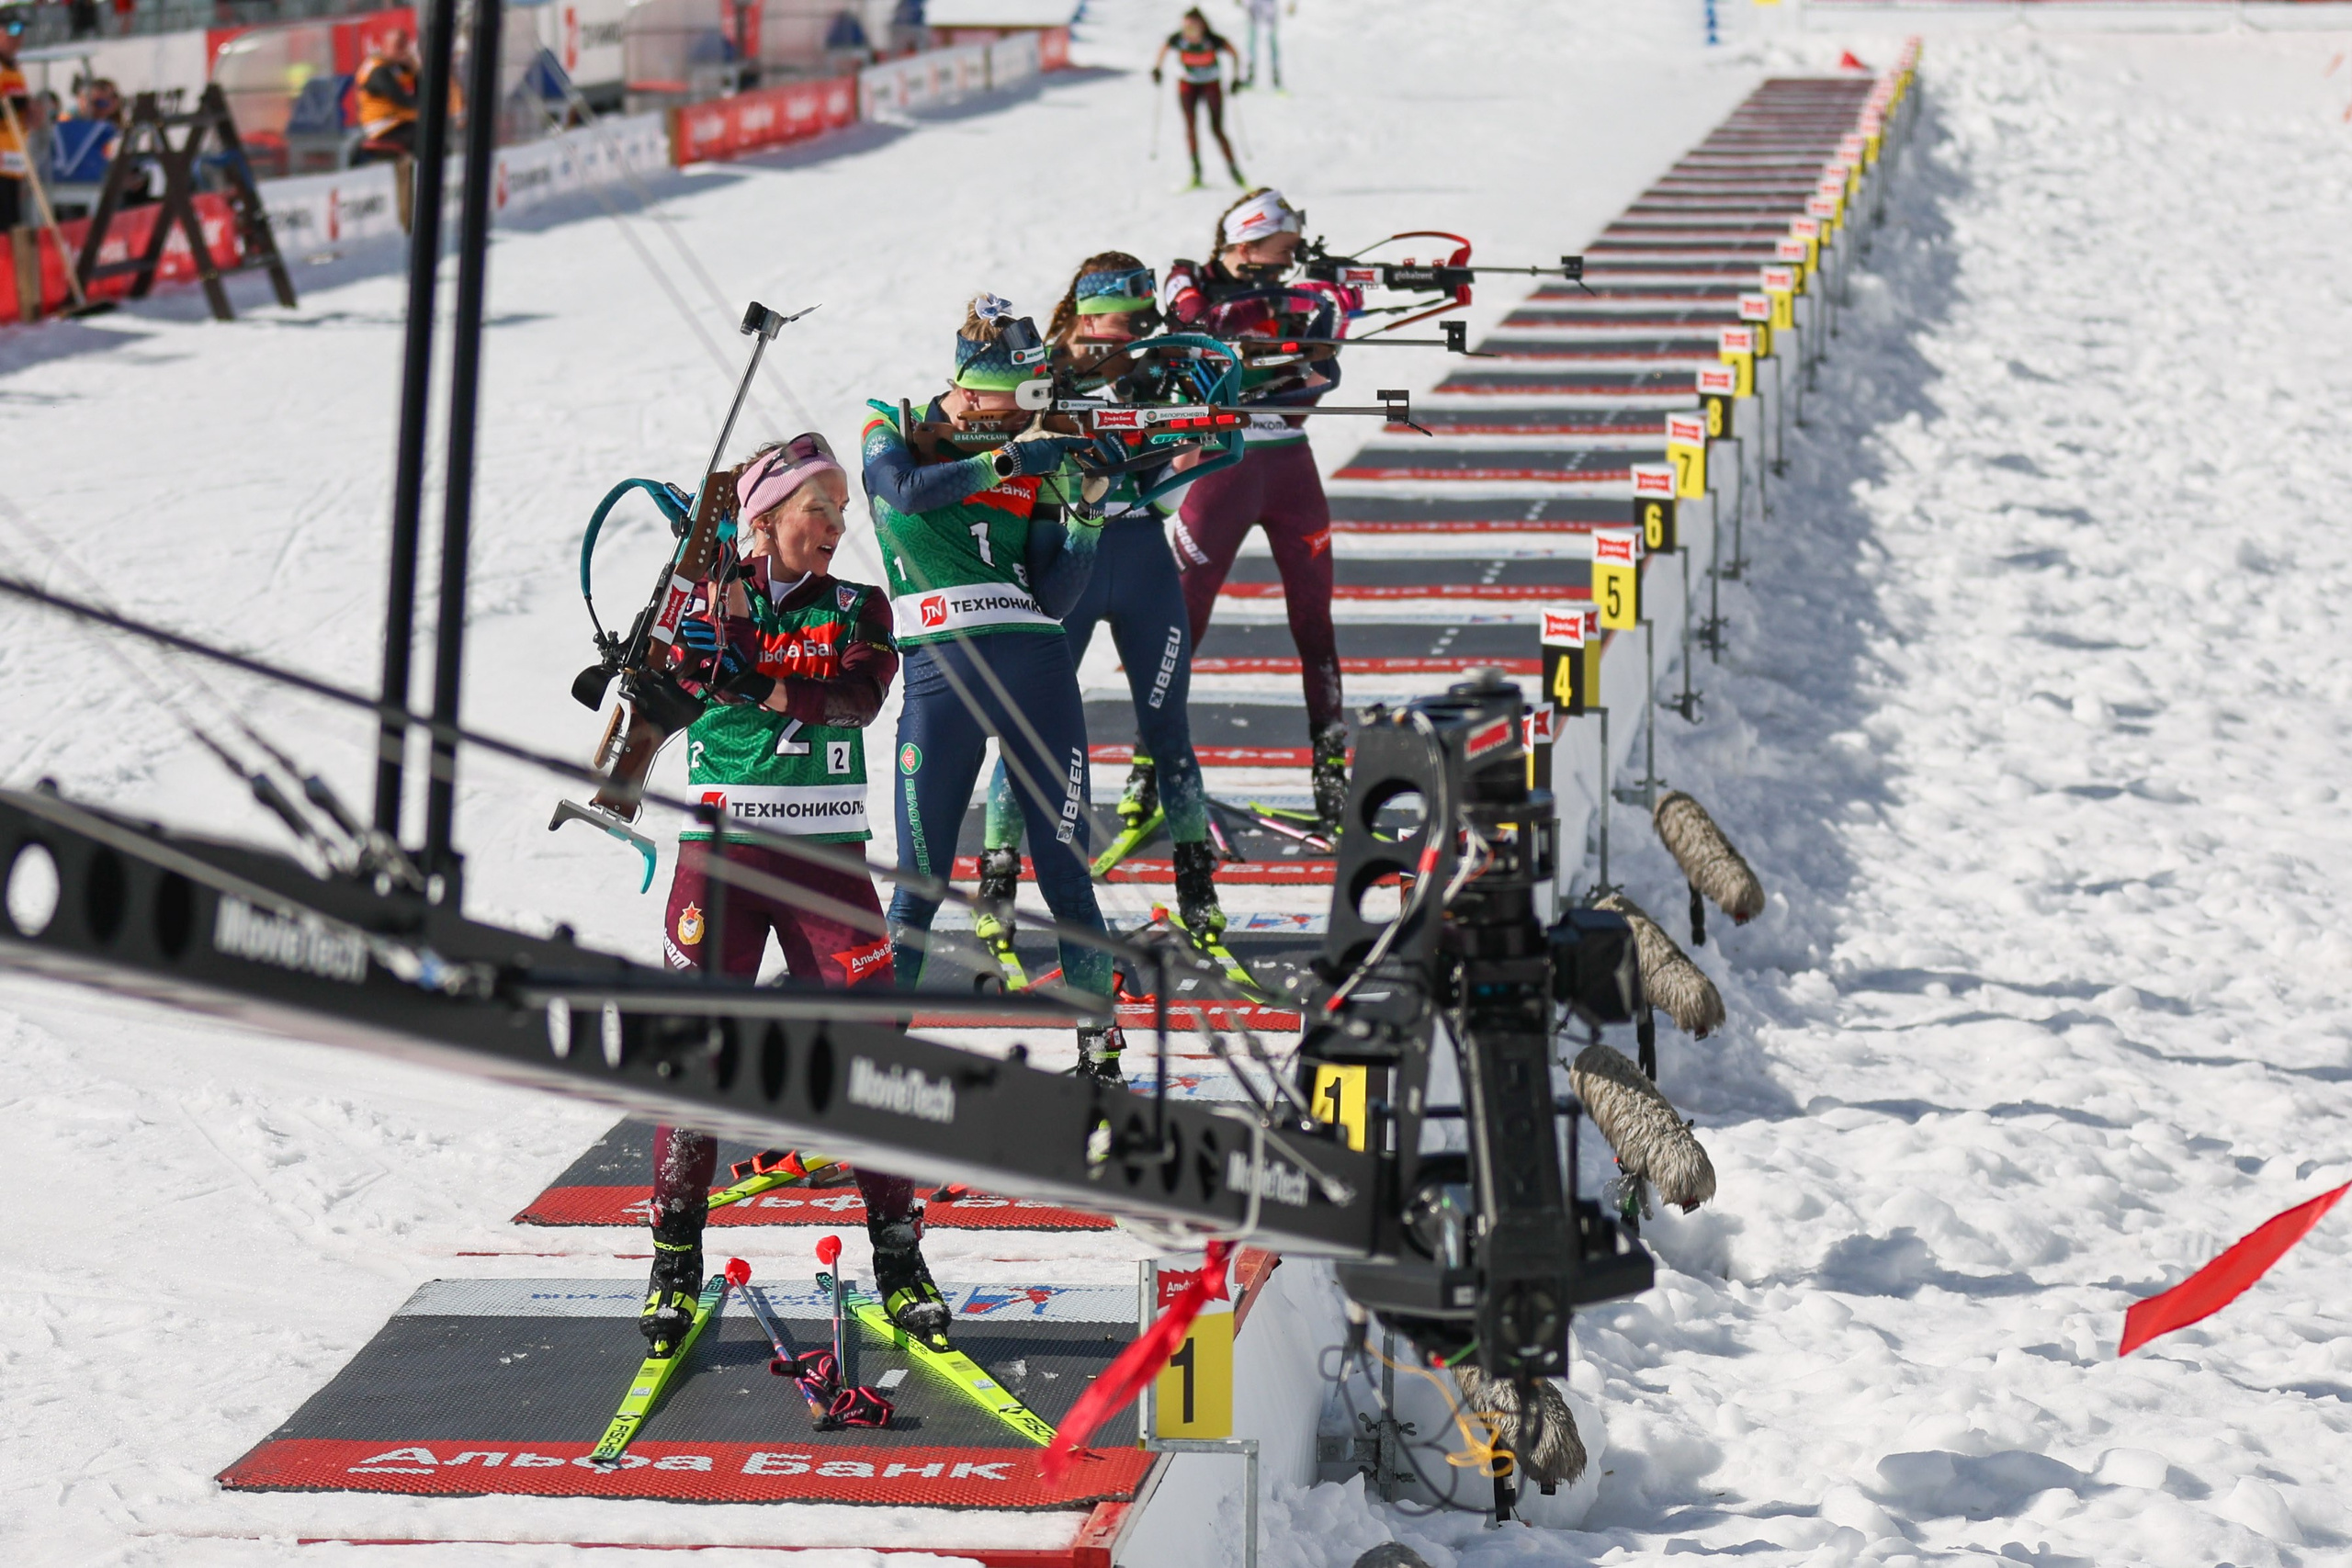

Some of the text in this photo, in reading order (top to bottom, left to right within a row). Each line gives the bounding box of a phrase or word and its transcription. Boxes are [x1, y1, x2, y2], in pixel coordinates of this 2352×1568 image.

[1706, 397, 1723, 437] 8
[1679, 453, 1691, 489] 7
[969, 521, 996, 569] 1
[1645, 502, 1663, 548] 6
[893, 556, 908, 581] 1
[1607, 575, 1622, 619] 5
[1553, 654, 1572, 707] 4
[690, 740, 705, 768] 2
[834, 747, 845, 770] 2
[731, 800, 865, 818] ТЕХНОНИКОЛЬ
[214, 894, 367, 983] MovieTech
[851, 944, 886, 973] Альфа
[848, 1056, 956, 1123] MovieTech
[1227, 1150, 1309, 1207] MoieTech
[1170, 1337, 1195, 1425] 1
[345, 1447, 1017, 1481] Альфа Банк
